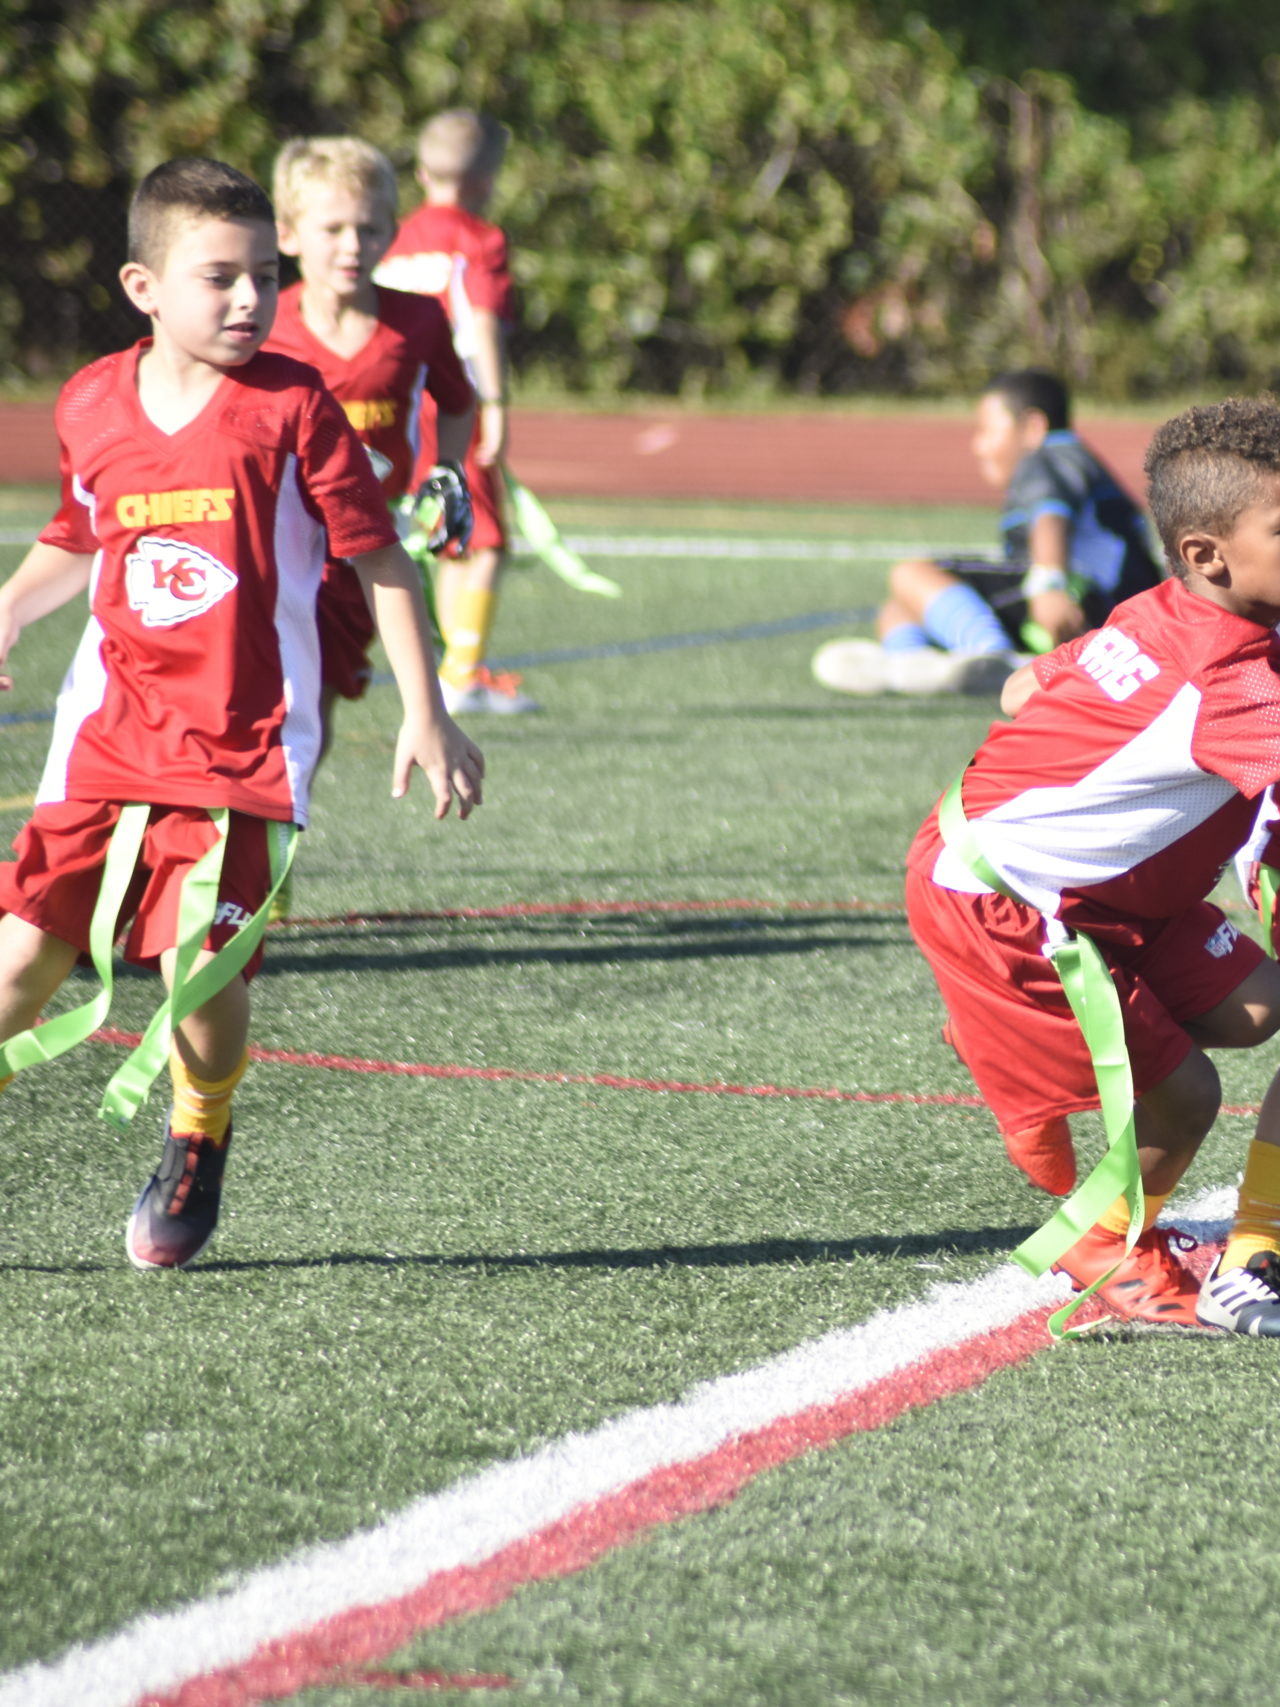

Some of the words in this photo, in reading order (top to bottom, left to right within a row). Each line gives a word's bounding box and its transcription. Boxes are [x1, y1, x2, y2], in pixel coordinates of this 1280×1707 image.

[341, 400, 397, 430] EFS
[116, 488, 236, 528] CHIEFS
[151, 557, 207, 601] KC
[1077, 625, 1160, 702] AG
[214, 902, 253, 930] FL
